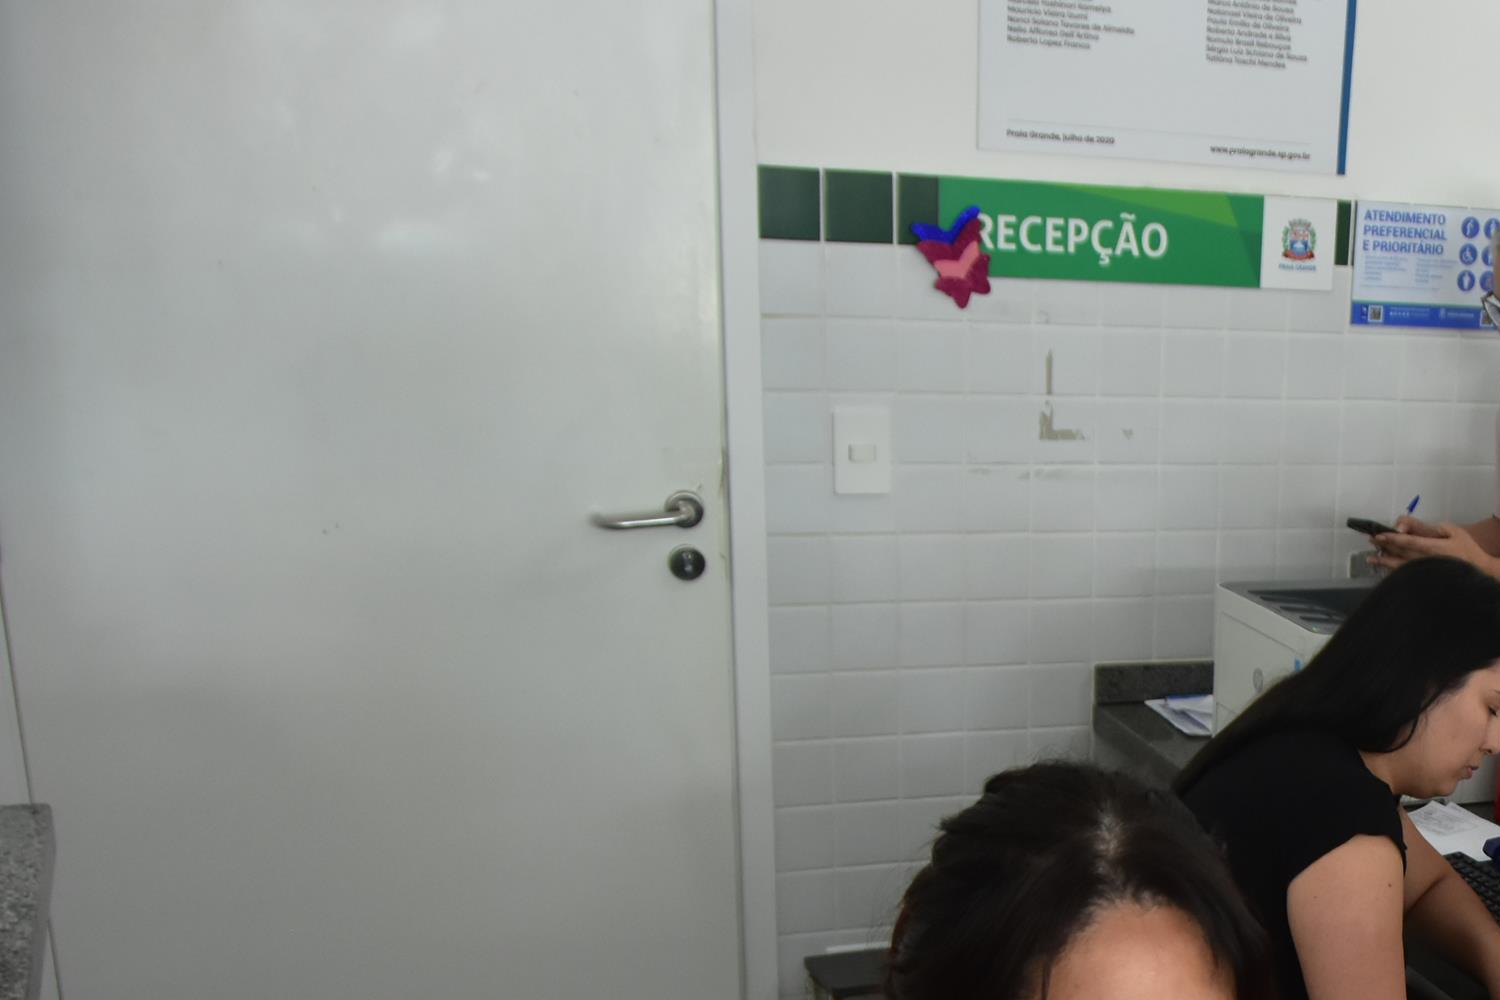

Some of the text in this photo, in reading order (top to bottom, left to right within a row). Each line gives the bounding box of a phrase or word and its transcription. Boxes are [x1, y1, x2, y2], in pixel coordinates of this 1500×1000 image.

[1364, 209, 1446, 225] ATENDIMENTO
[978, 211, 1169, 265] RECEPÇÃO
[1363, 225, 1447, 241] PREFERENCIAL
[1362, 238, 1444, 255] E PRIORITÁRIO
